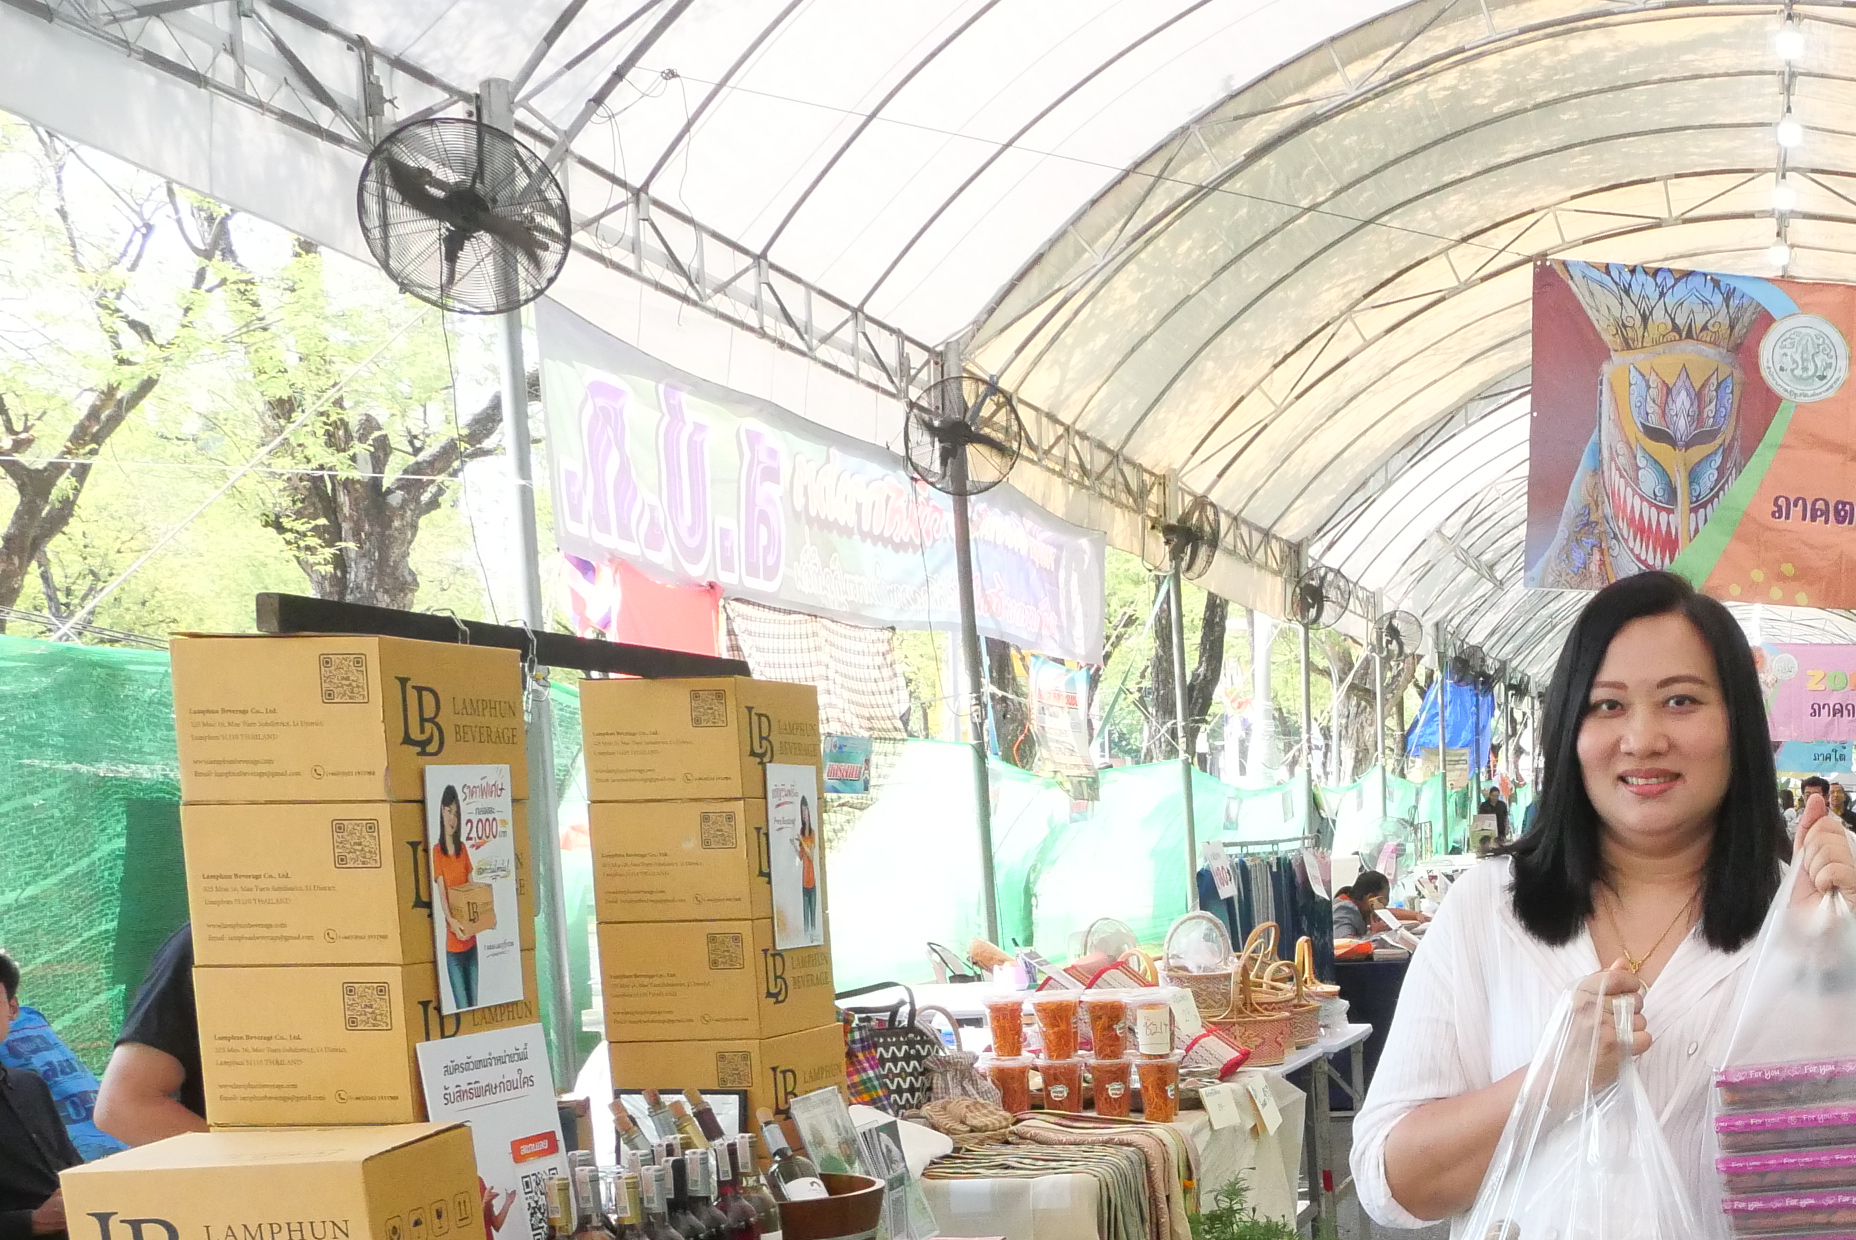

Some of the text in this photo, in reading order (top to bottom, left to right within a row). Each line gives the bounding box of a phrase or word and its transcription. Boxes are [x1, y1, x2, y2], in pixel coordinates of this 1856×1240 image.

[395, 676, 445, 757] LB
[453, 696, 517, 717] LAMPHUN
[454, 724, 518, 746] BEVERAGE
[745, 706, 774, 765] LB
[1812, 745, 1847, 764] ภาคใต้
[465, 817, 498, 842] 2,000
[761, 949, 788, 1005] LB
[442, 1043, 529, 1077] สมัครตัวแทนจำหน่ายวันนี้
[1750, 1070, 1764, 1078] For
[1764, 1069, 1780, 1081] you
[1820, 1064, 1835, 1076] you
[442, 1069, 535, 1106] รับสิทธิพิเศษก่อนใคร
[1786, 1198, 1799, 1206] For
